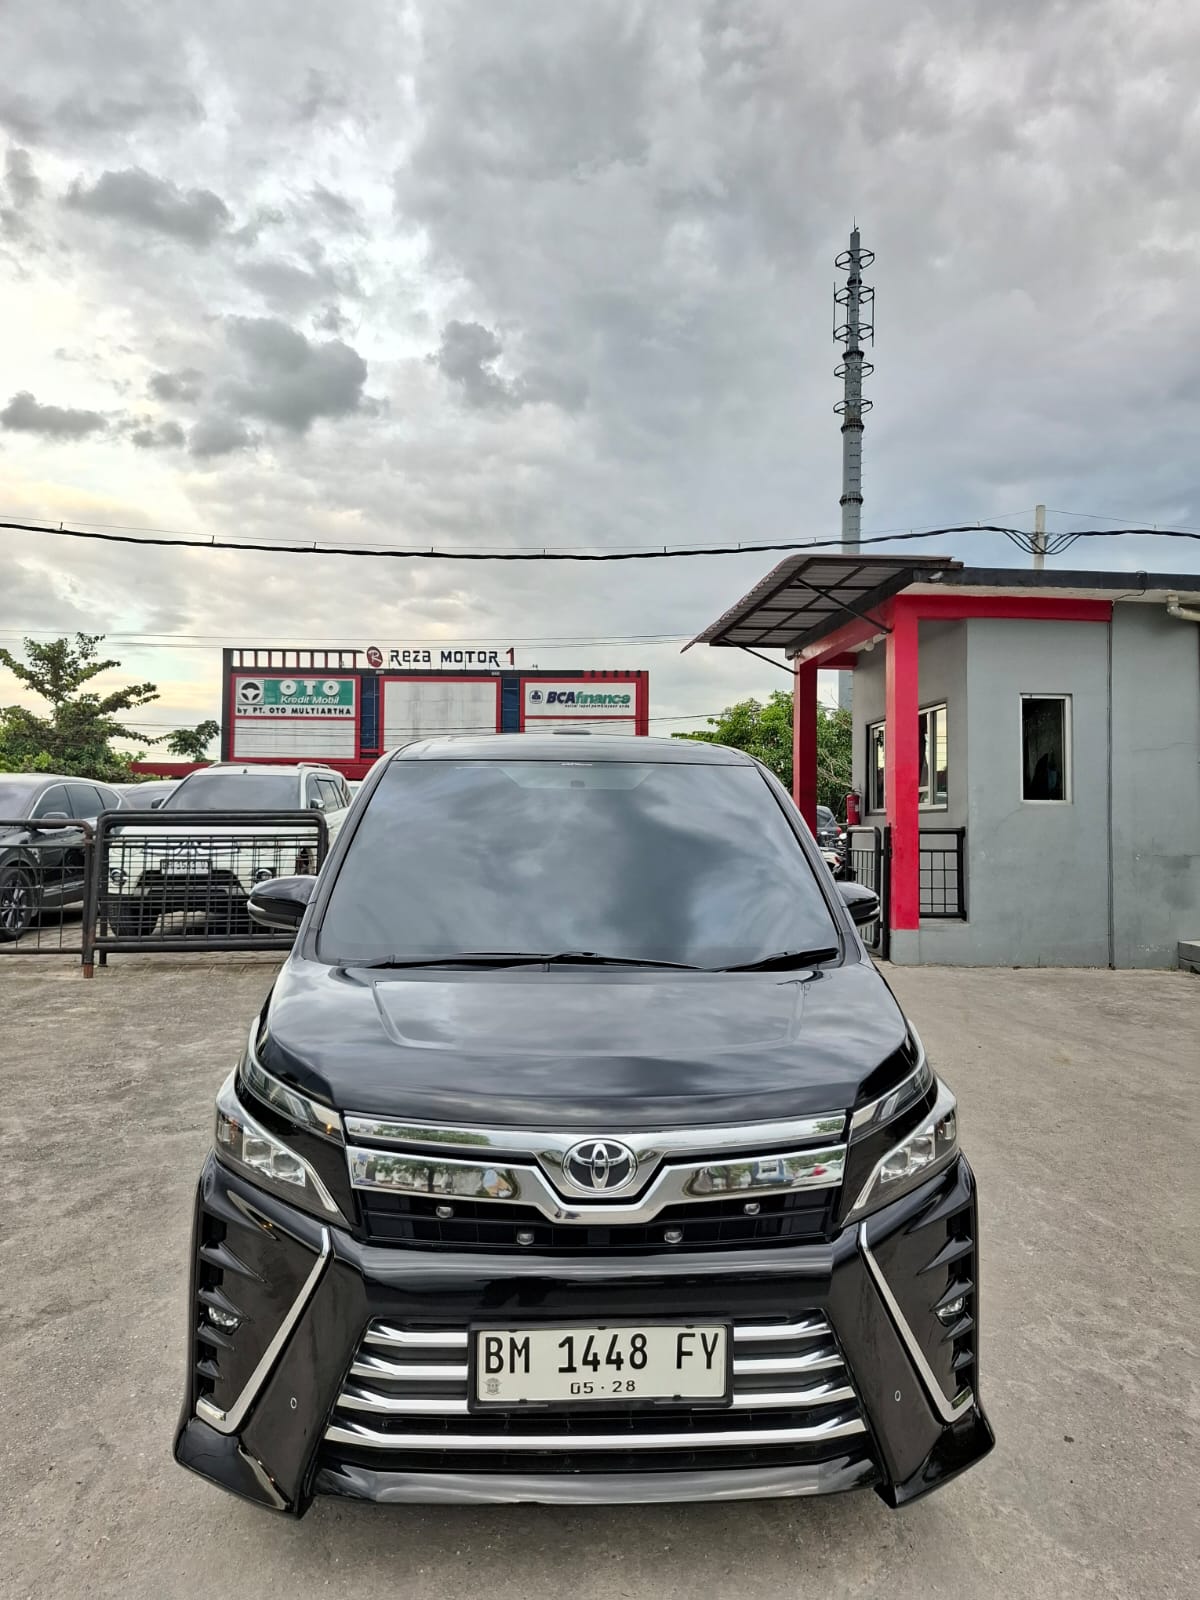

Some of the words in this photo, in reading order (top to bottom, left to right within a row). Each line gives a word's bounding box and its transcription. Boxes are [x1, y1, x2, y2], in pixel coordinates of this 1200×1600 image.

[441, 650, 500, 667] MOTOR
[506, 647, 515, 665] 1
[280, 680, 340, 696] OTO
[280, 696, 310, 704] Kredit
[312, 696, 340, 704] Mobil
[237, 707, 248, 715] by
[290, 707, 352, 715] MULTIARTHA
[485, 1336, 530, 1374] BM
[557, 1332, 648, 1374] 1448
[676, 1332, 719, 1370] FY
